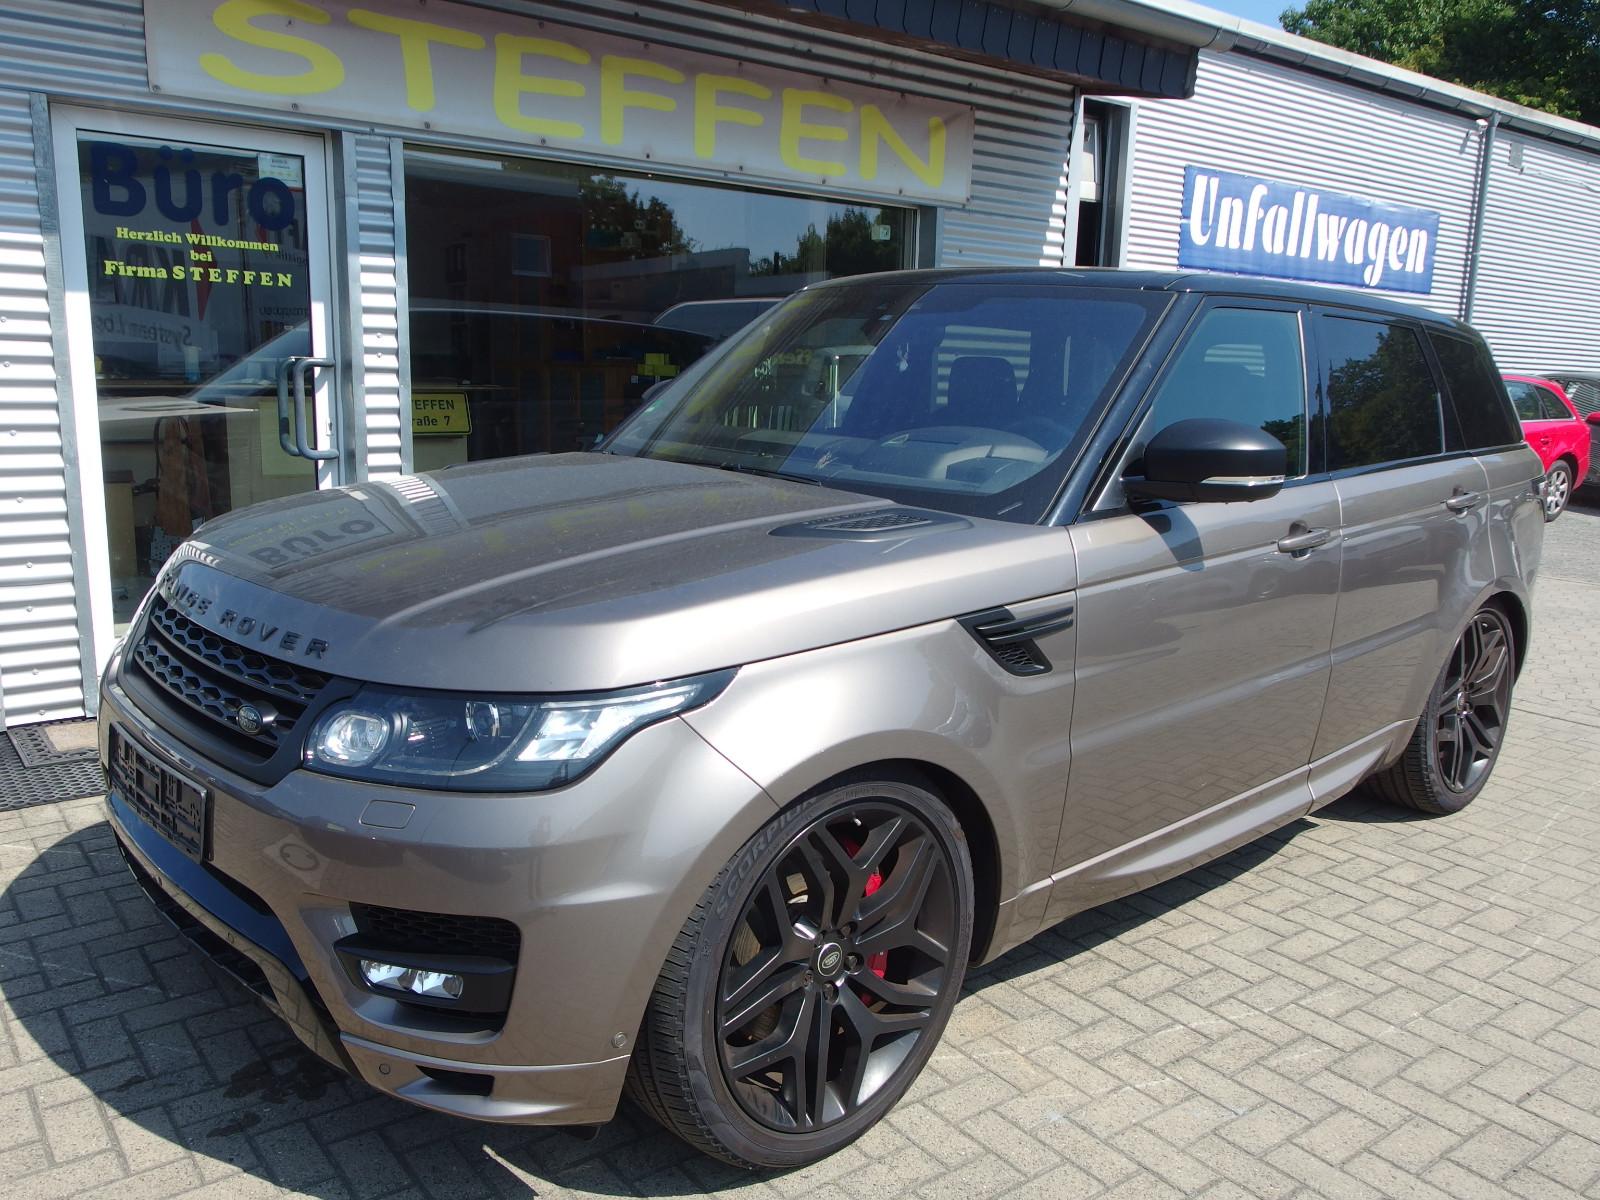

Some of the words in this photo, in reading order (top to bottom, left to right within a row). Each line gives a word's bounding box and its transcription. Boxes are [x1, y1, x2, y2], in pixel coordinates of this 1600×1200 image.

[202, 0, 945, 188] STEFFEN
[91, 142, 295, 231] Büro
[116, 227, 182, 243] Herzlich
[185, 233, 279, 251] Willkommen
[1189, 174, 1429, 286] Unfallwagen
[190, 250, 213, 262] bei
[104, 260, 168, 279] Firma
[411, 399, 455, 410] EFFEN
[443, 415, 450, 426] 7
[219, 608, 329, 660] ROVER
